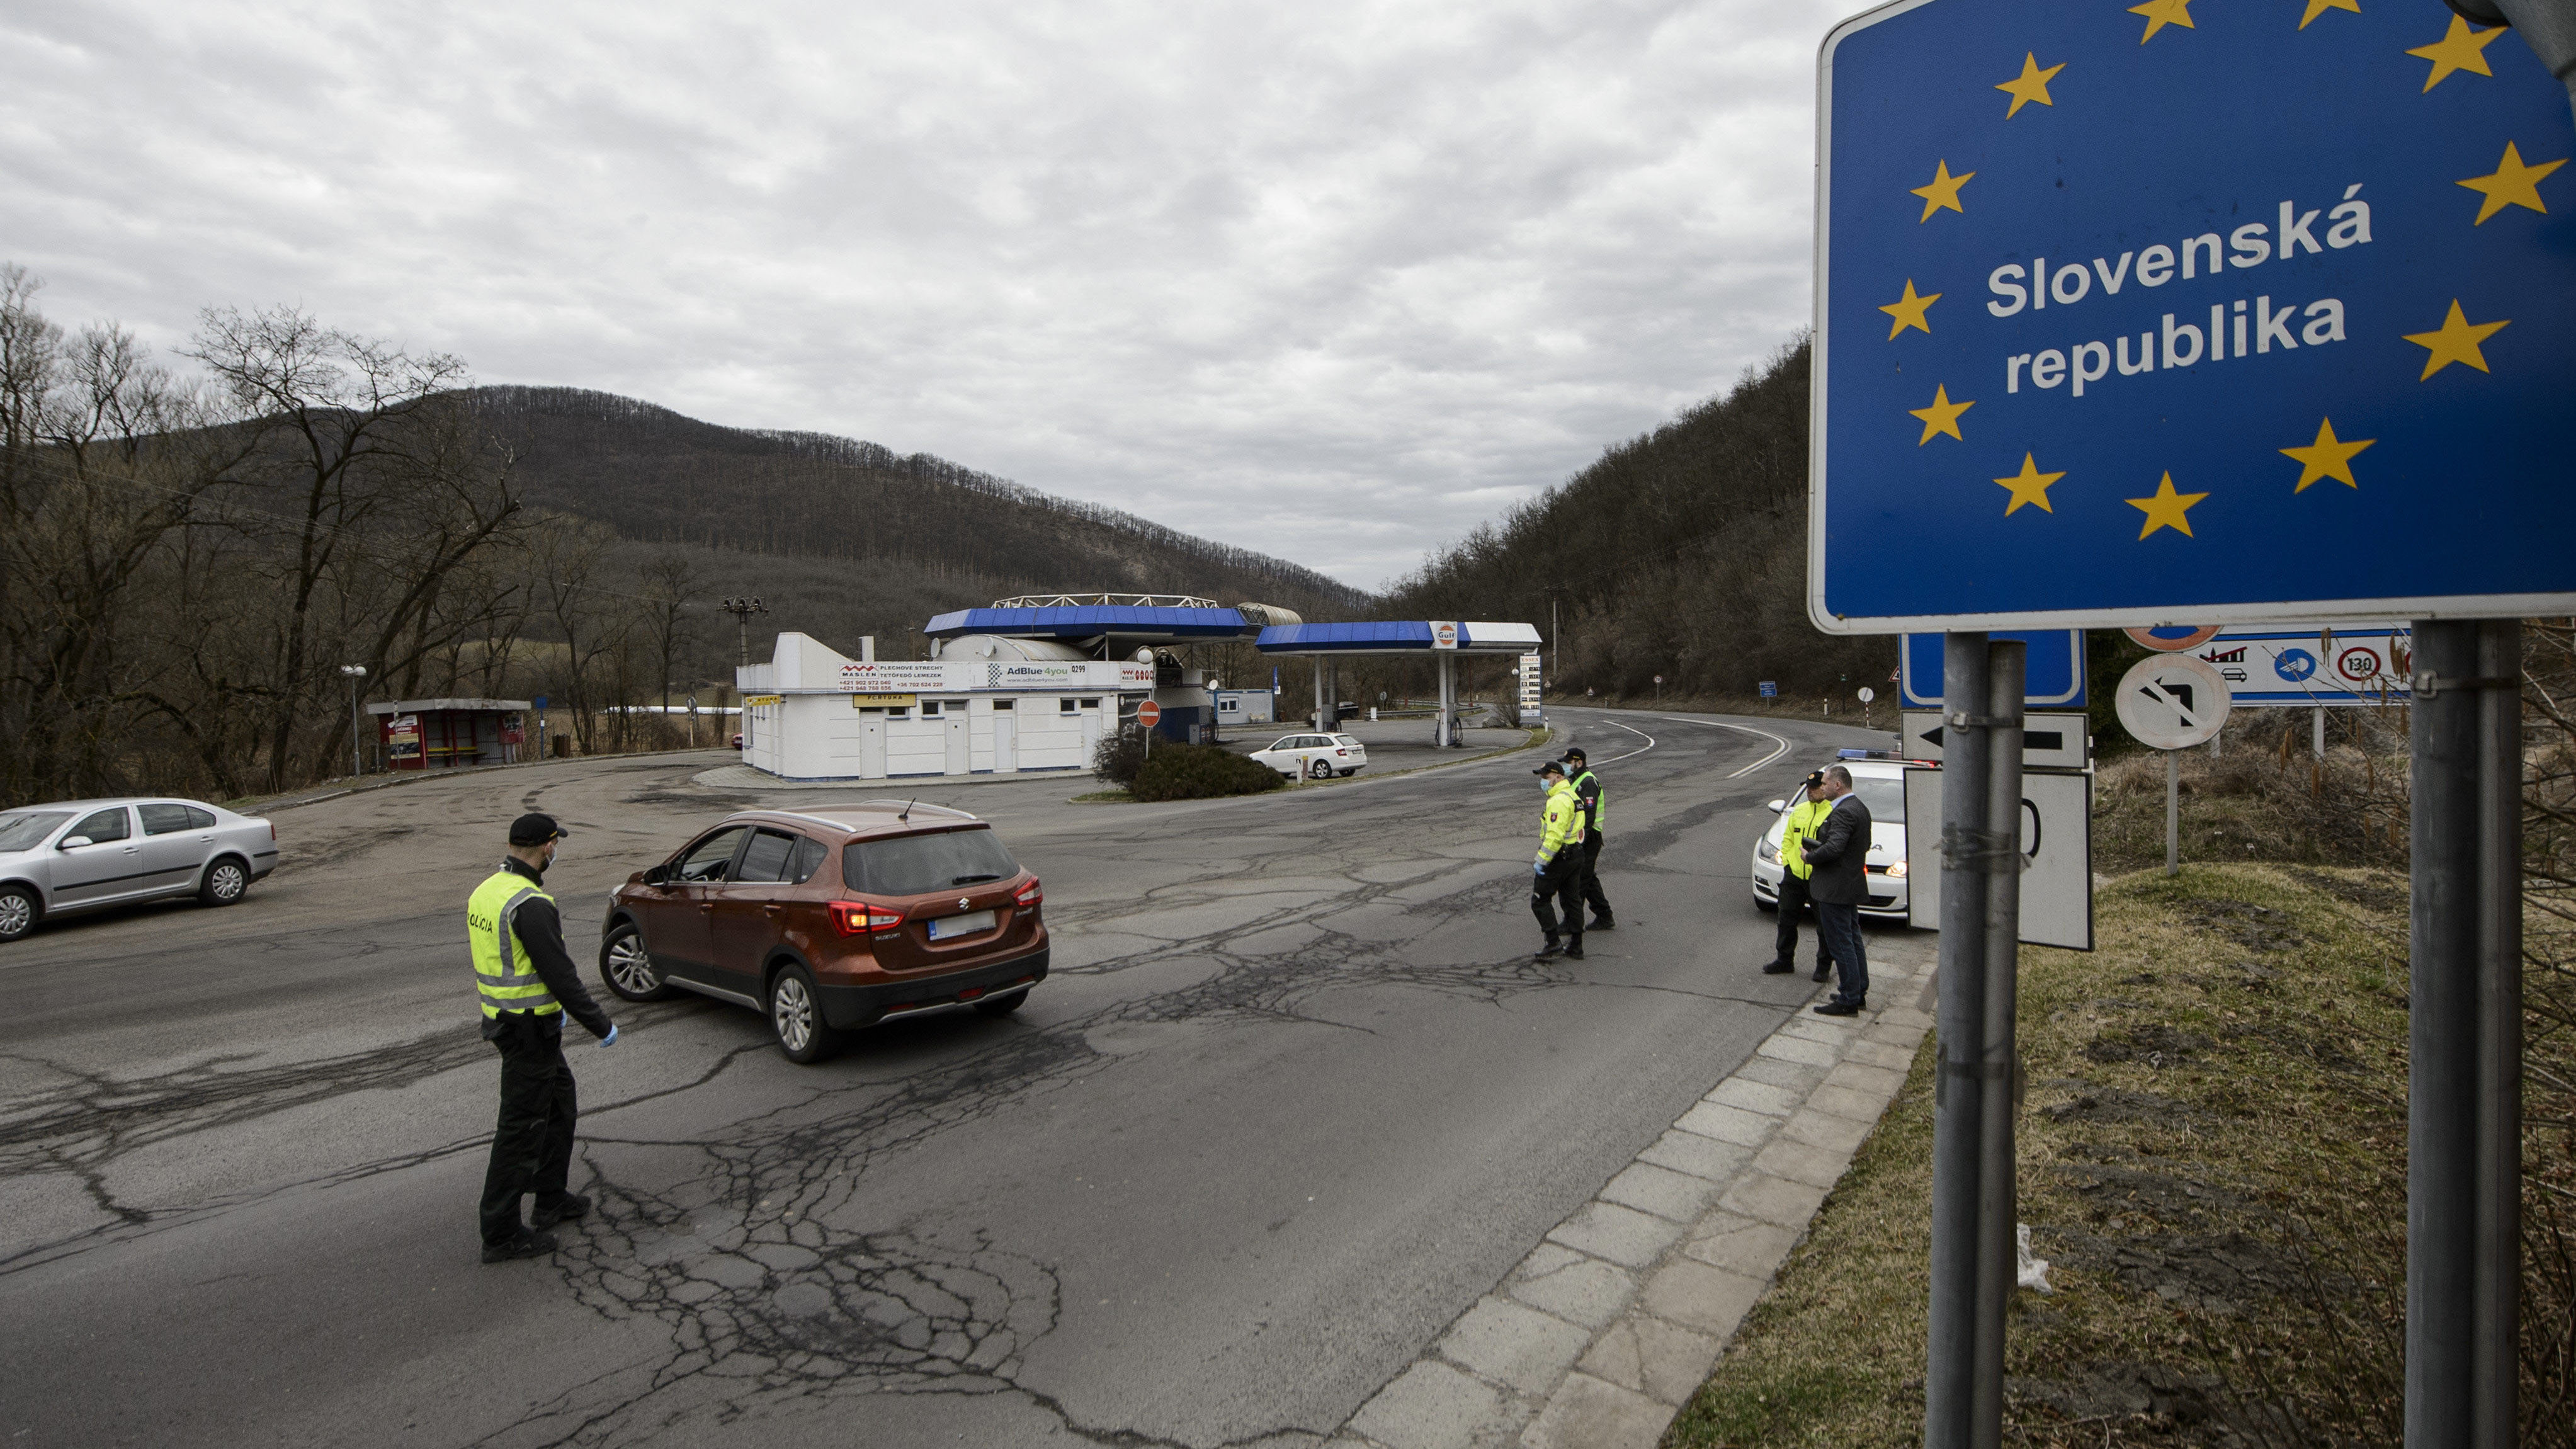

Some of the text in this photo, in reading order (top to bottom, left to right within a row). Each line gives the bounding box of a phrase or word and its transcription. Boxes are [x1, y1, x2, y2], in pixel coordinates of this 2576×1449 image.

[1987, 183, 2373, 318] Slovenská
[2007, 295, 2346, 397] republika
[1007, 667, 1068, 676] AdBlue 4you
[2347, 657, 2372, 671] 130
[467, 913, 492, 933] OLÍCIA
